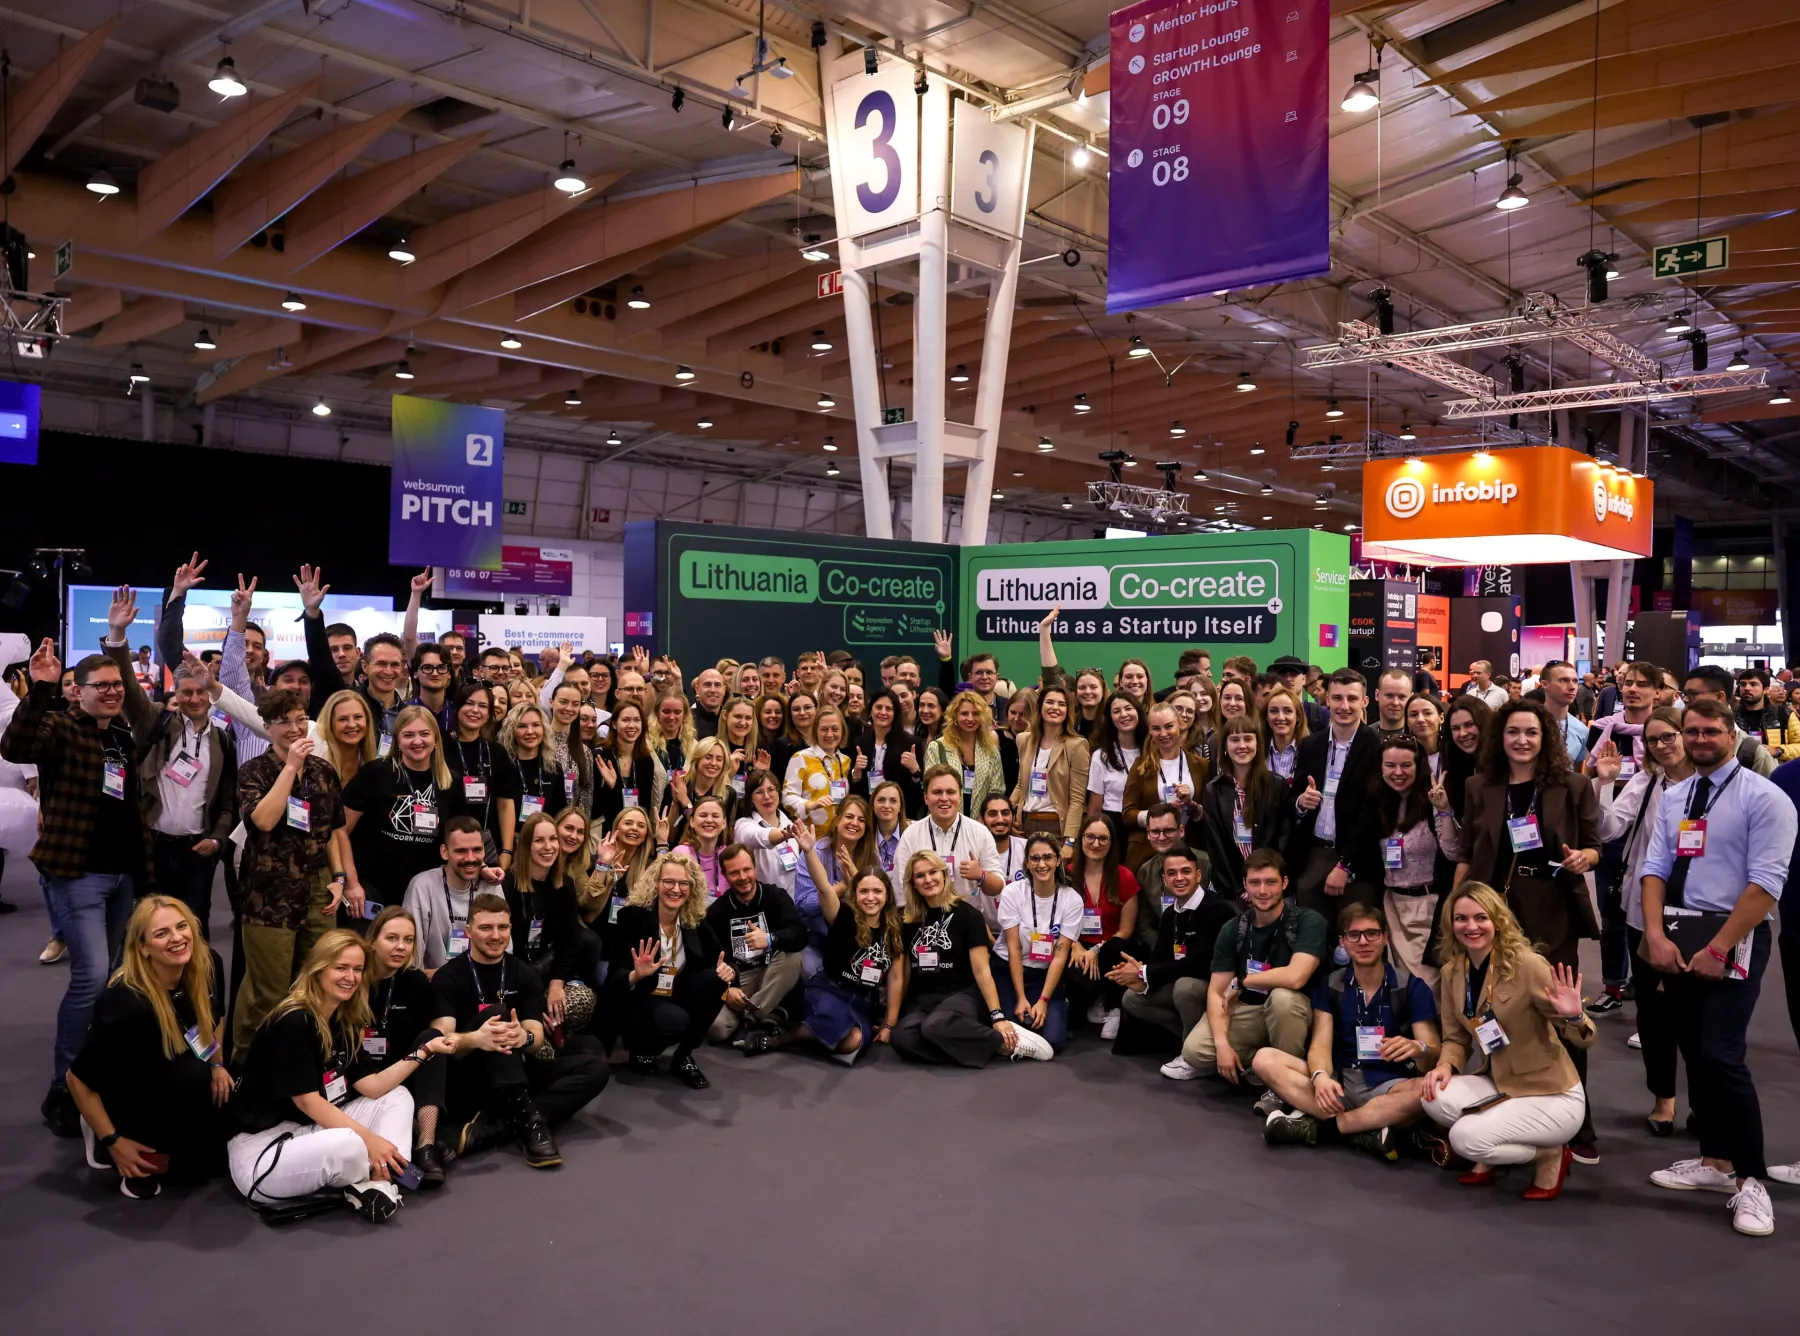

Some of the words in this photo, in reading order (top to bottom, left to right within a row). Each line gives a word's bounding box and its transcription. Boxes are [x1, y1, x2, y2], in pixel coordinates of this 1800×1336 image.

[1153, 11, 1197, 35] Mentor
[1200, 0, 1239, 18] Hours
[1153, 42, 1199, 66] Startup
[1201, 25, 1250, 50] Lounge
[1152, 54, 1210, 85] GROWTH
[1213, 43, 1261, 67] Lounge
[1153, 87, 1181, 102] STAGE
[1152, 98, 1190, 130] 09
[855, 90, 901, 213] 3
[1152, 144, 1181, 158] STAGE
[975, 150, 999, 213] 3
[1152, 155, 1190, 187] 08
[472, 438, 488, 462] 2
[403, 479, 465, 494] websummit
[1432, 479, 1518, 504] infobip
[402, 494, 493, 526] PITCH
[1608, 491, 1634, 522] infobip
[449, 569, 460, 578] 05
[479, 571, 490, 579] 07
[691, 561, 808, 594] Lithuania
[827, 569, 935, 599] Co-create
[1119, 571, 1266, 599] Co-create
[985, 576, 1098, 602] Lithuania
[505, 629, 525, 638] Best
[528, 630, 584, 639] e-commerce
[910, 617, 931, 626] Startup
[986, 616, 1069, 635] Lithuaia
[1074, 621, 1096, 635] as
[1102, 621, 1113, 635] a
[1119, 616, 1197, 639] Startup
[1204, 615, 1263, 635] Itself
[505, 638, 549, 647] operating
[551, 640, 583, 648] syem
